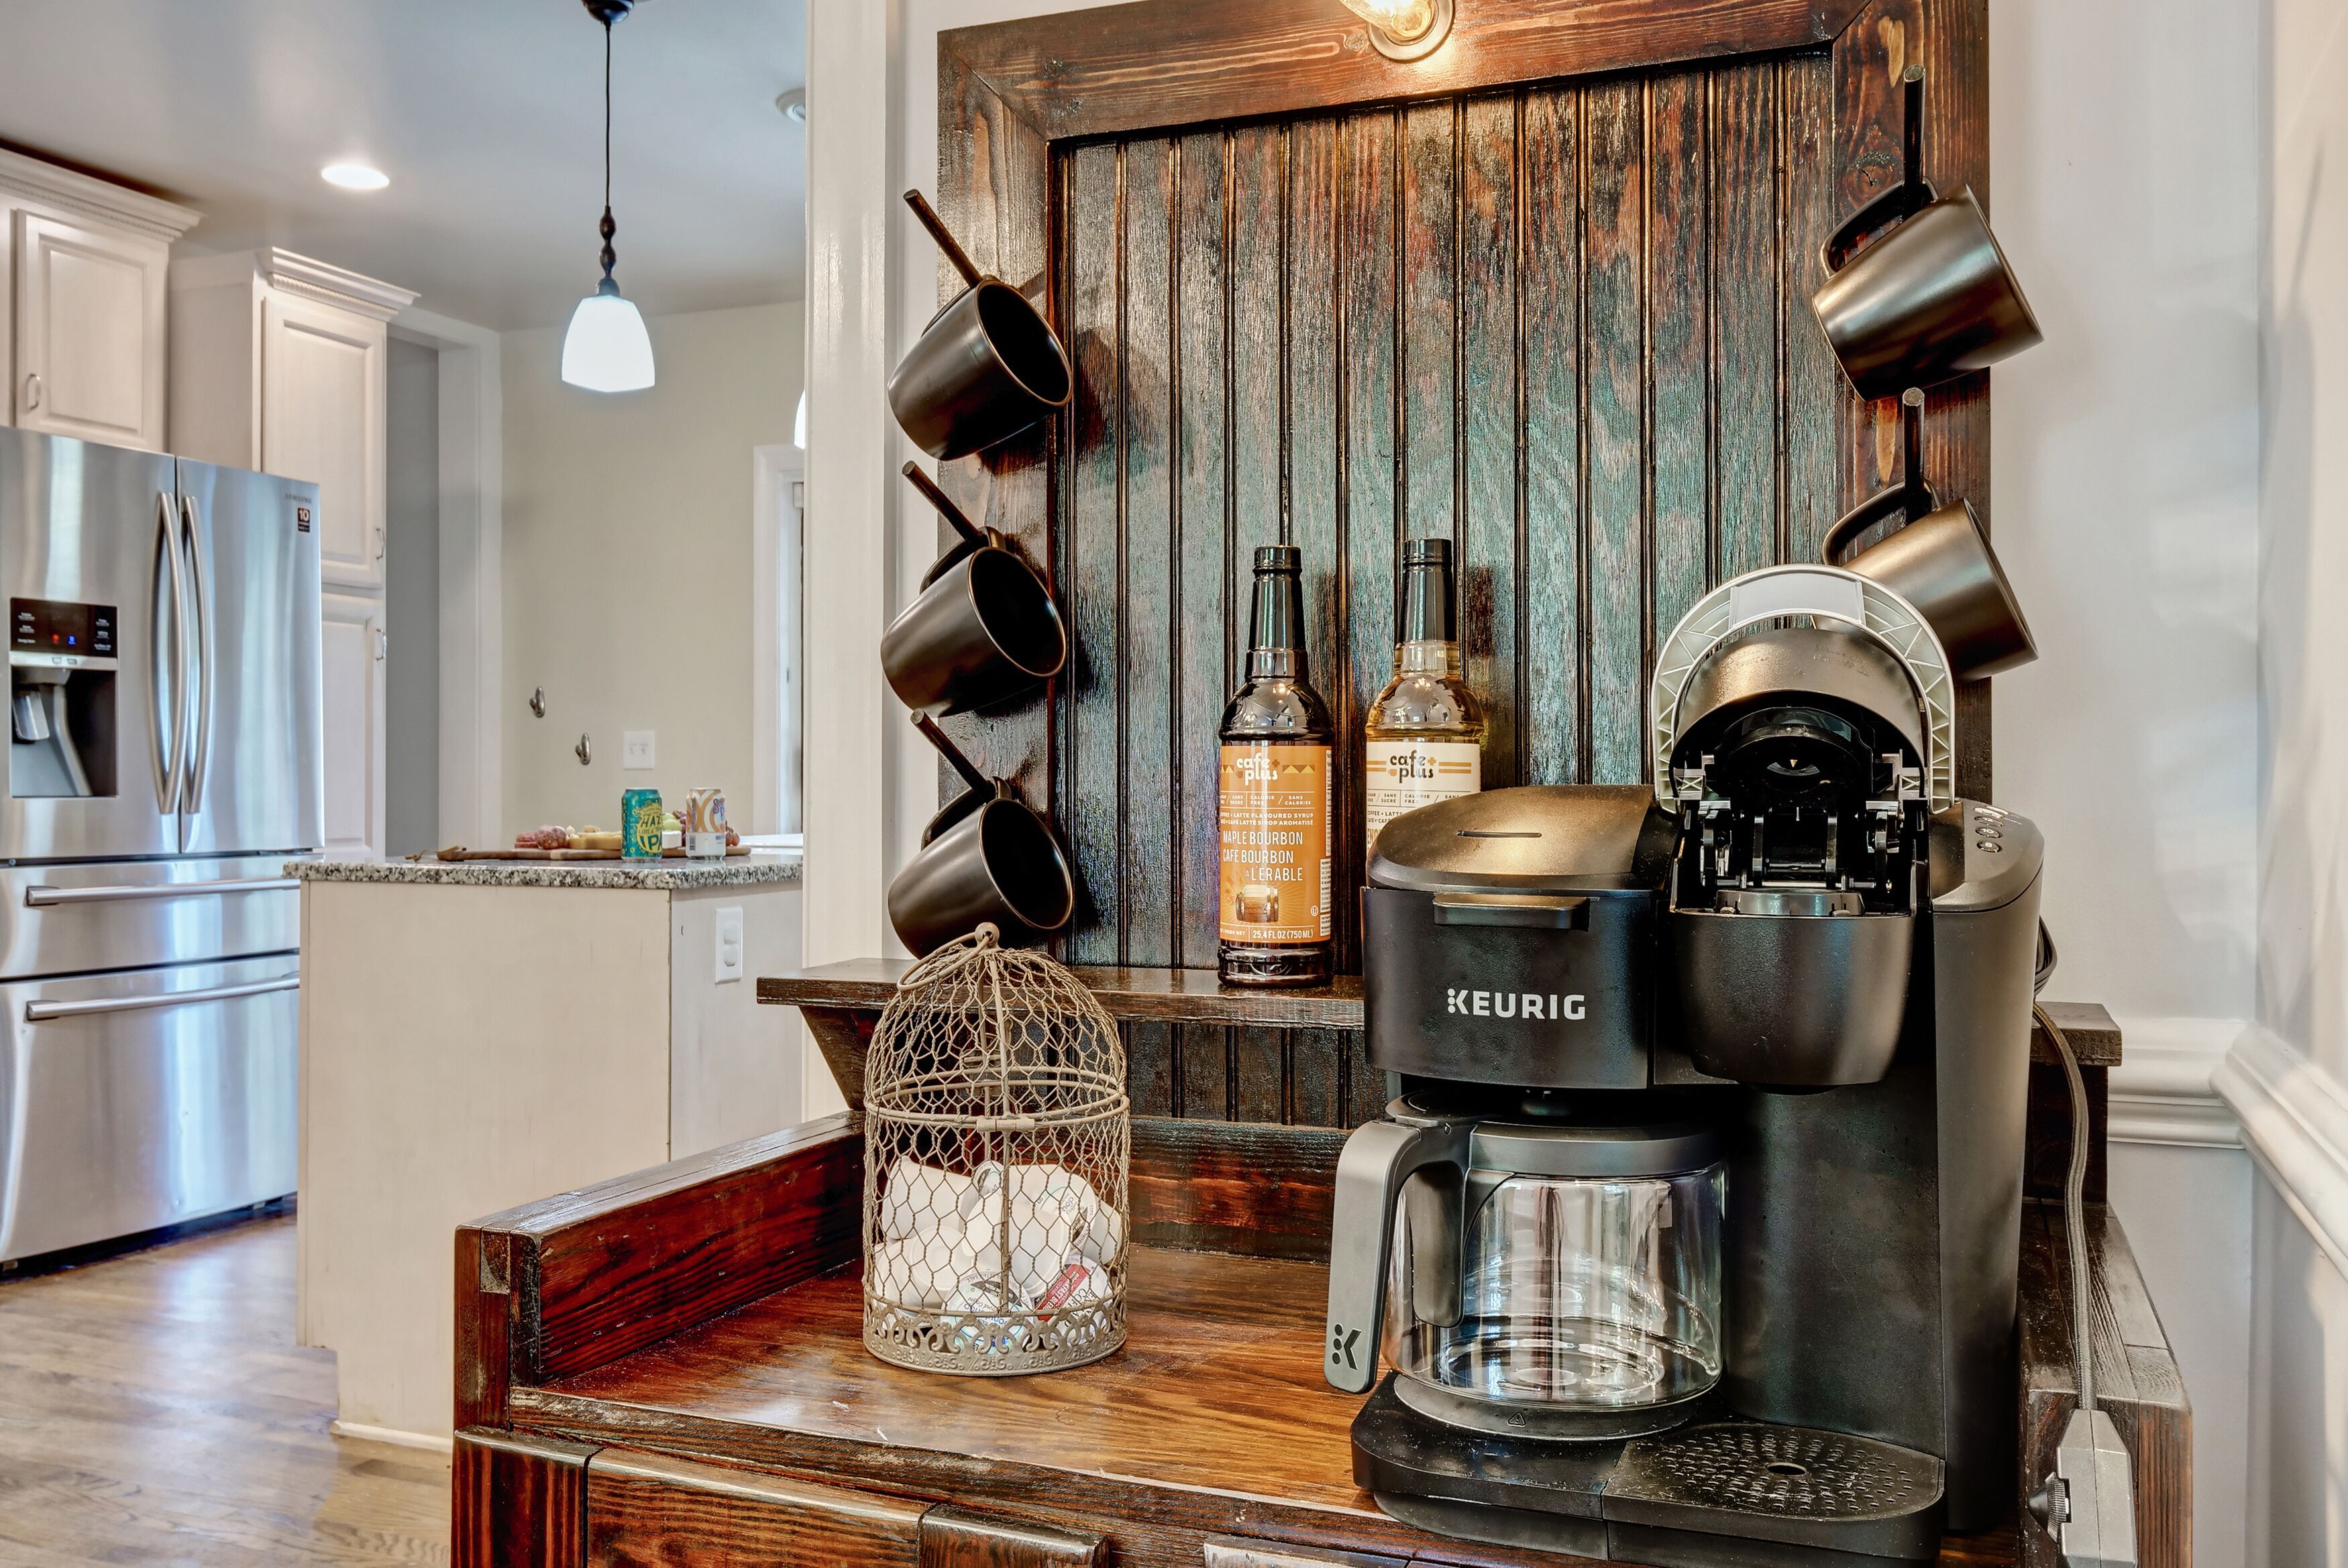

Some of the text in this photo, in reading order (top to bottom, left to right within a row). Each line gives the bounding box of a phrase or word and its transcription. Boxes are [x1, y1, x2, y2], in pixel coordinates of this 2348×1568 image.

[299, 510, 309, 521] 10
[1236, 752, 1270, 769] cafe
[1389, 750, 1426, 766] cafe
[1244, 769, 1278, 786] plus
[1399, 767, 1434, 783] plus
[1223, 830, 1303, 845] MAPLE BOURBON
[1223, 847, 1293, 864] CAFÉ BOURBON
[1277, 930, 1286, 939] OZ
[1447, 988, 1586, 1020] KEURIG
